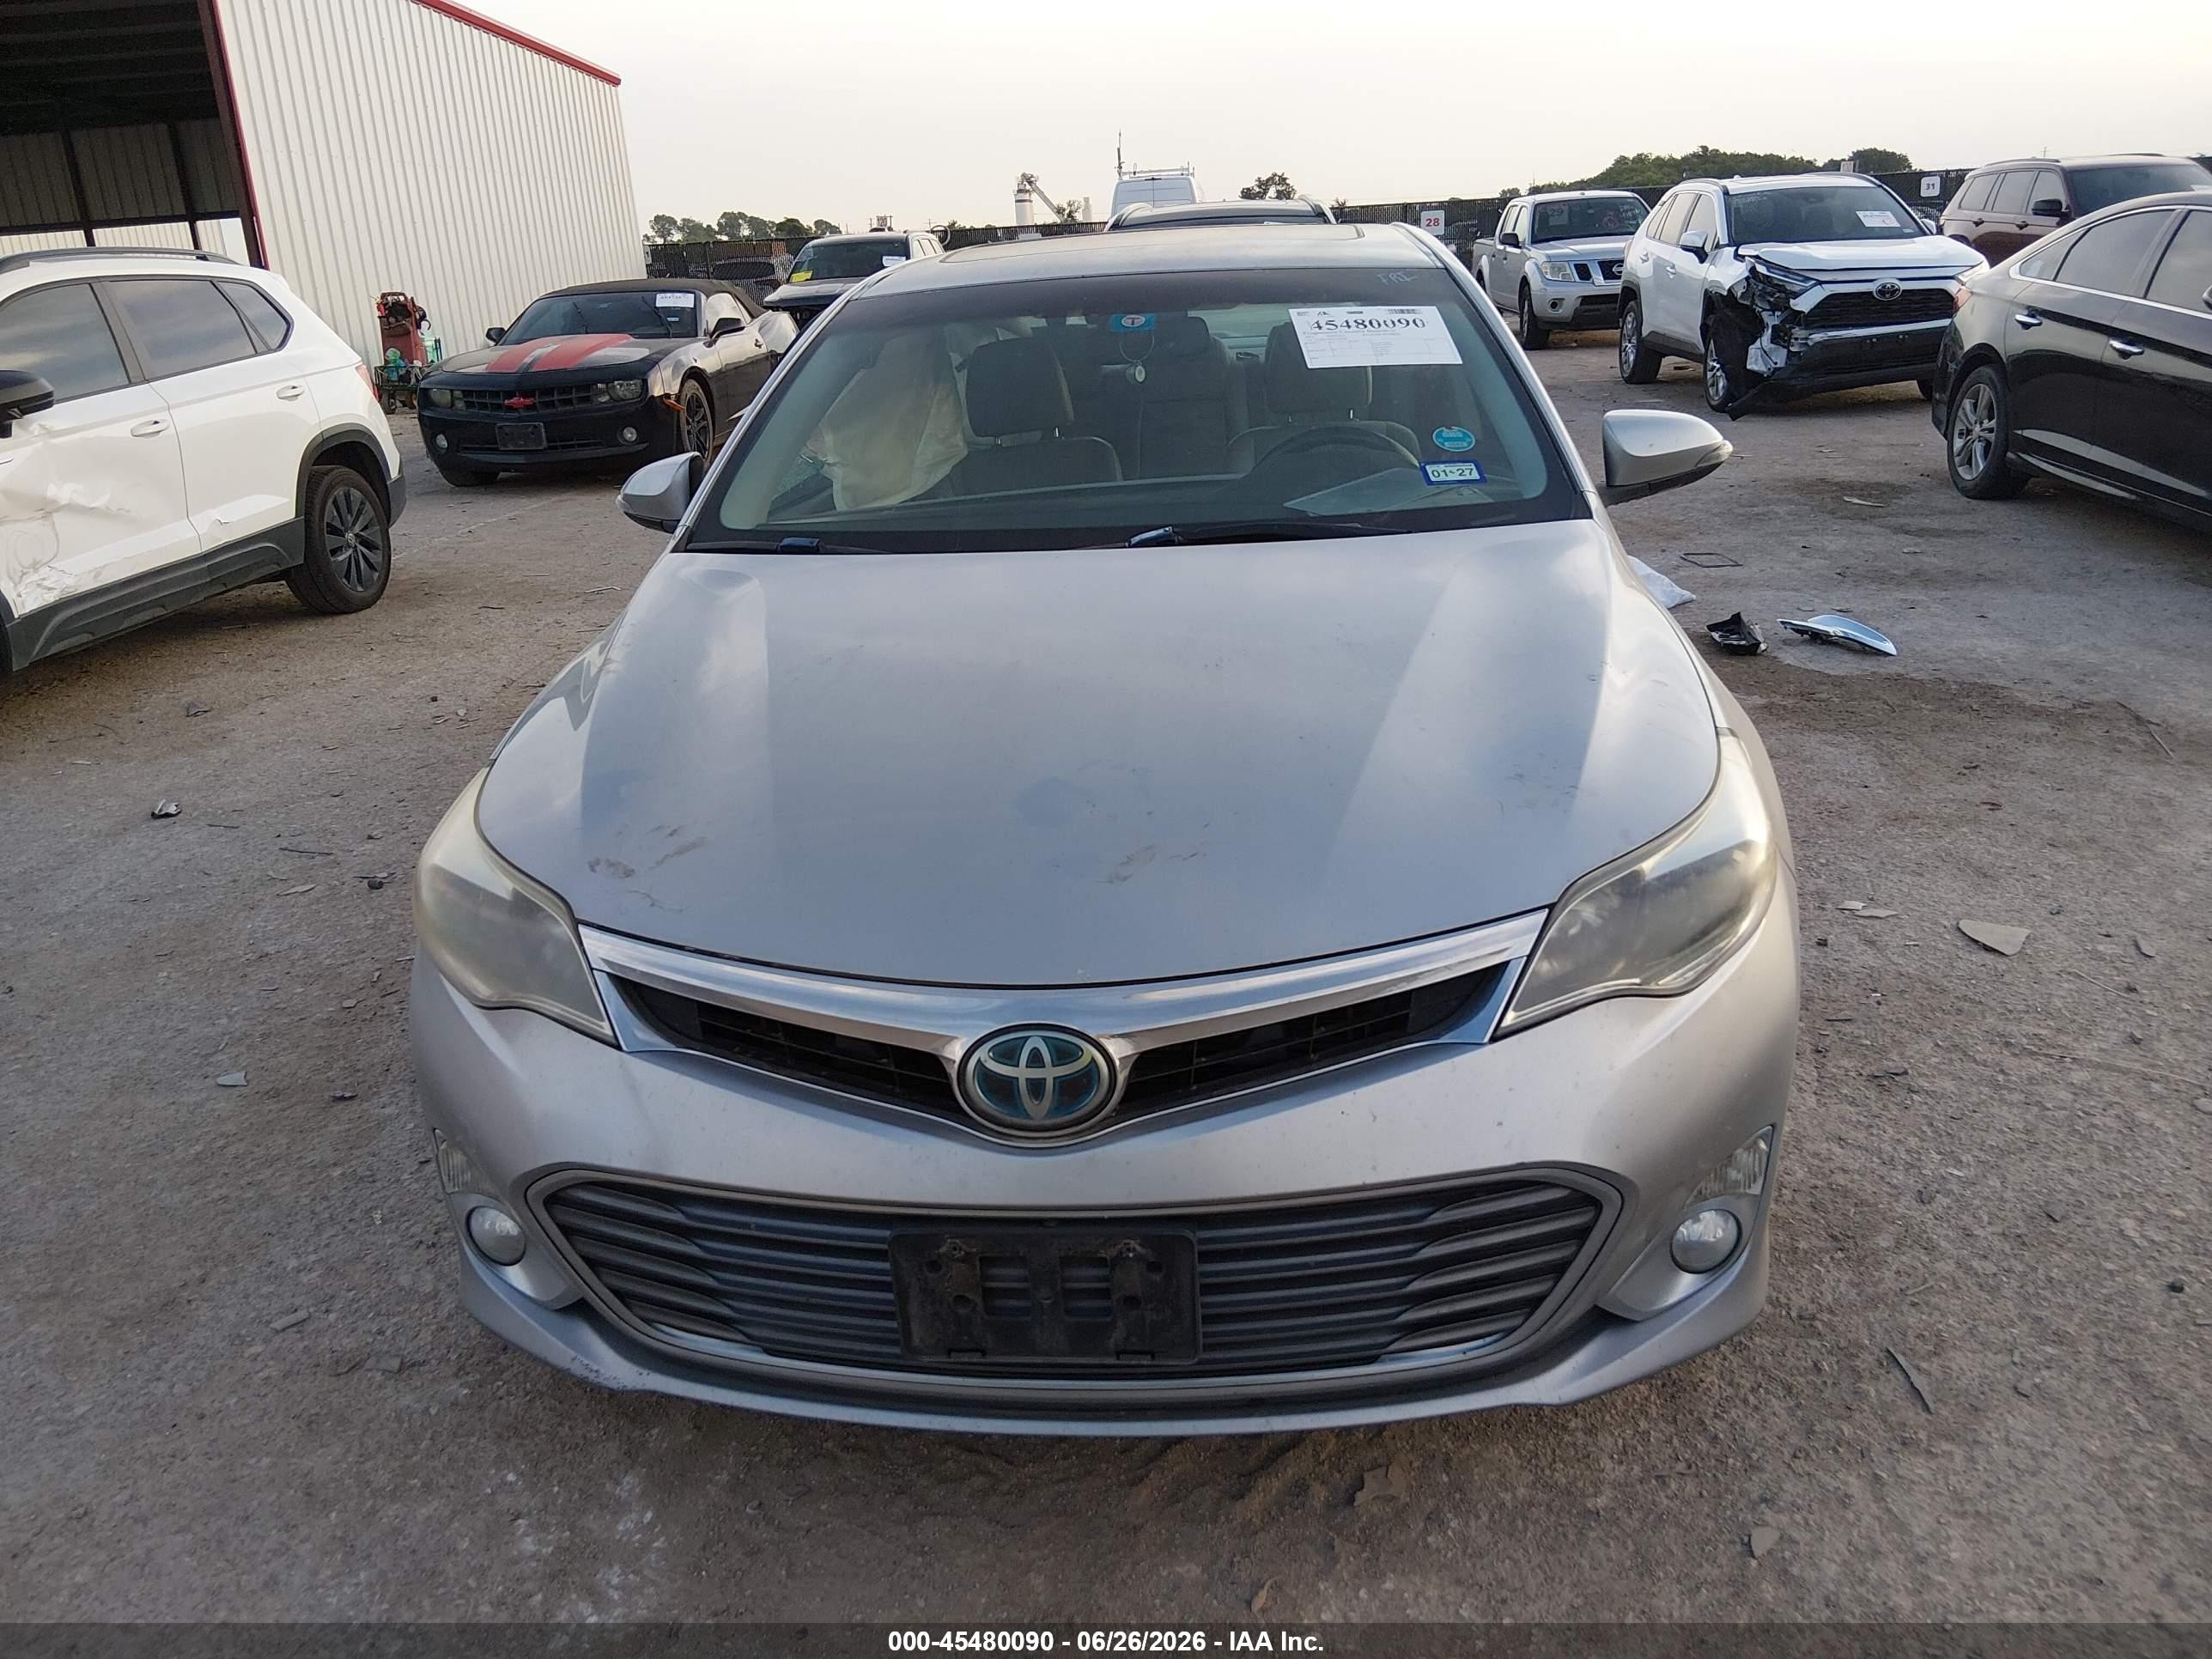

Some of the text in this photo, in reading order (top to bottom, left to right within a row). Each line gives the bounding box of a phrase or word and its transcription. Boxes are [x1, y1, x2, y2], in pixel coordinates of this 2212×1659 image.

[1925, 182, 1936, 191] 31
[1425, 217, 1440, 228] 28
[1311, 317, 1426, 331] 45480090
